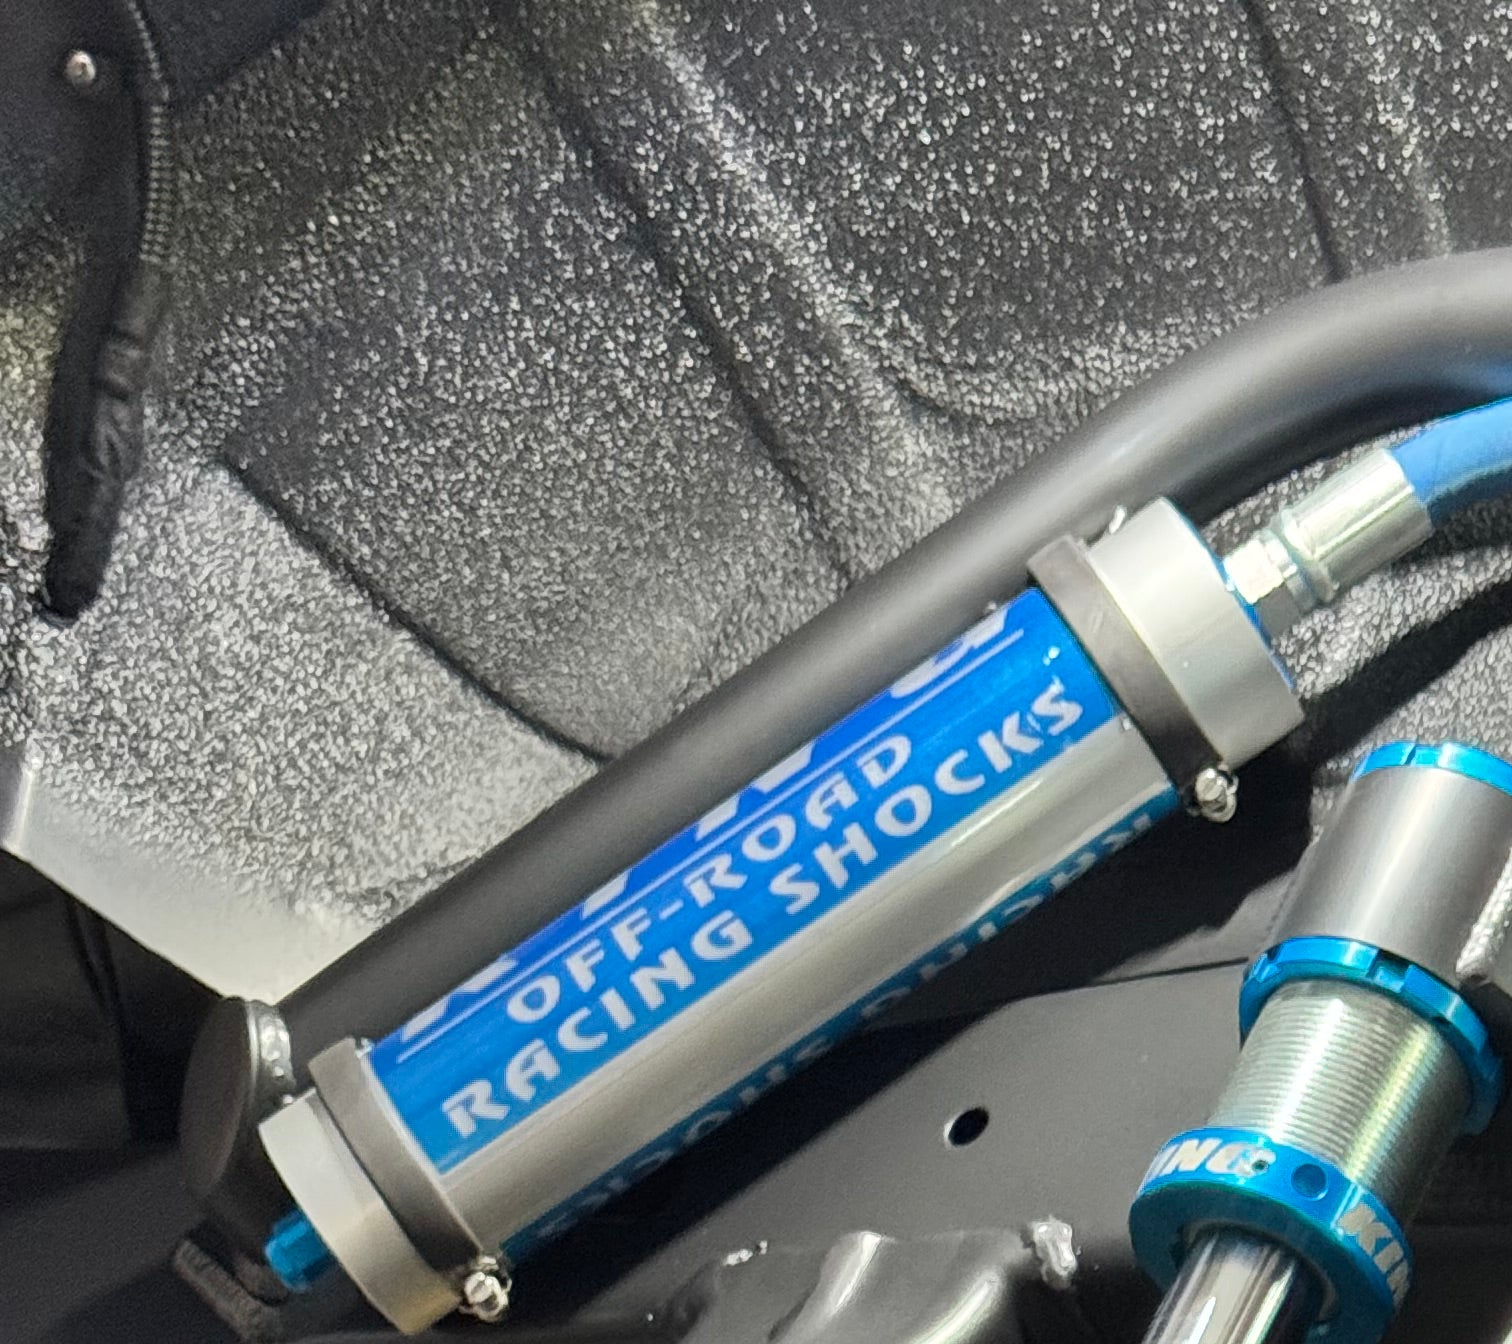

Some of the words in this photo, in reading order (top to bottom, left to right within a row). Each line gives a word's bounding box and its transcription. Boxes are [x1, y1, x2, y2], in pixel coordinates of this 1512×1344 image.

[441, 911, 753, 1139] RACING
[769, 678, 1084, 915] SHOCKS
[506, 733, 912, 1023] OFF-ROAD
